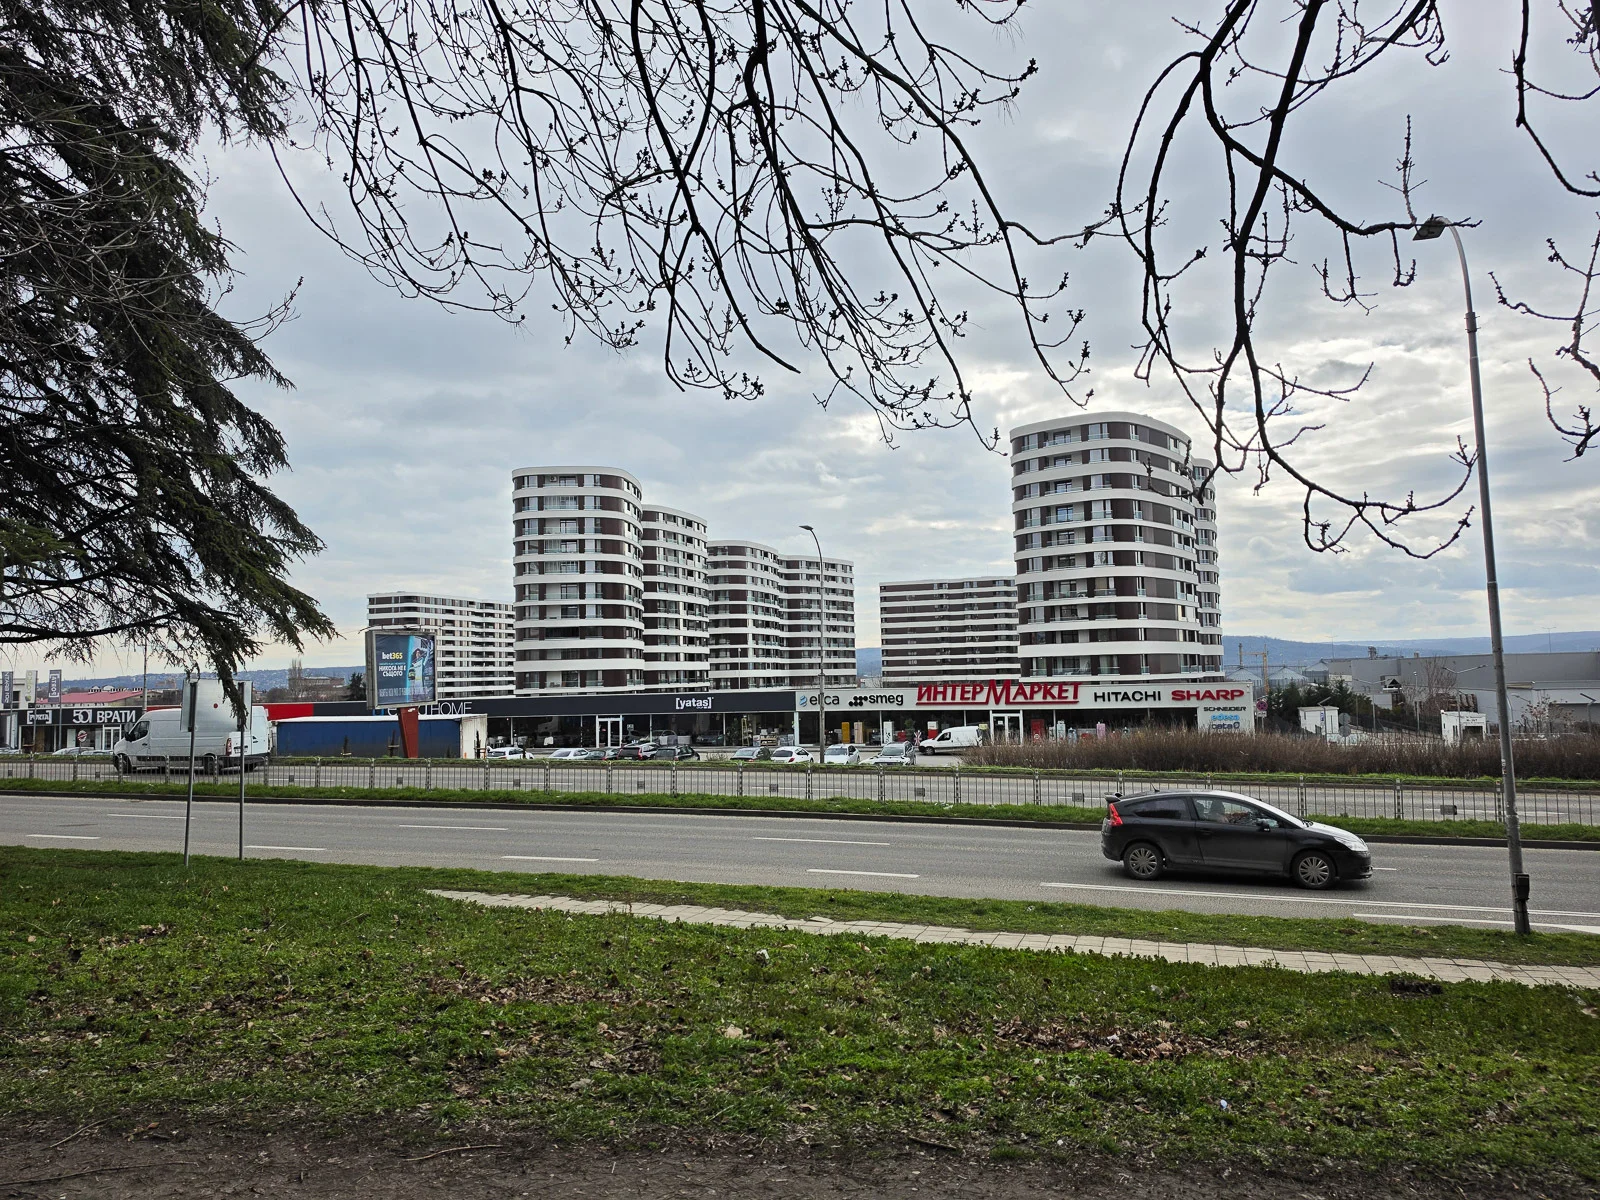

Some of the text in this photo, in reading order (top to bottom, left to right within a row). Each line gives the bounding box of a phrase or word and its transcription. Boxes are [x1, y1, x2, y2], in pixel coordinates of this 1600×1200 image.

[382, 652, 403, 660] bet365
[809, 693, 840, 705] elca
[868, 694, 904, 706] smeg
[1094, 690, 1162, 702] HITACHI
[1171, 689, 1245, 701] SHARP
[72, 709, 136, 723] 501 ВРАТИ
[1211, 713, 1240, 721] edesa
